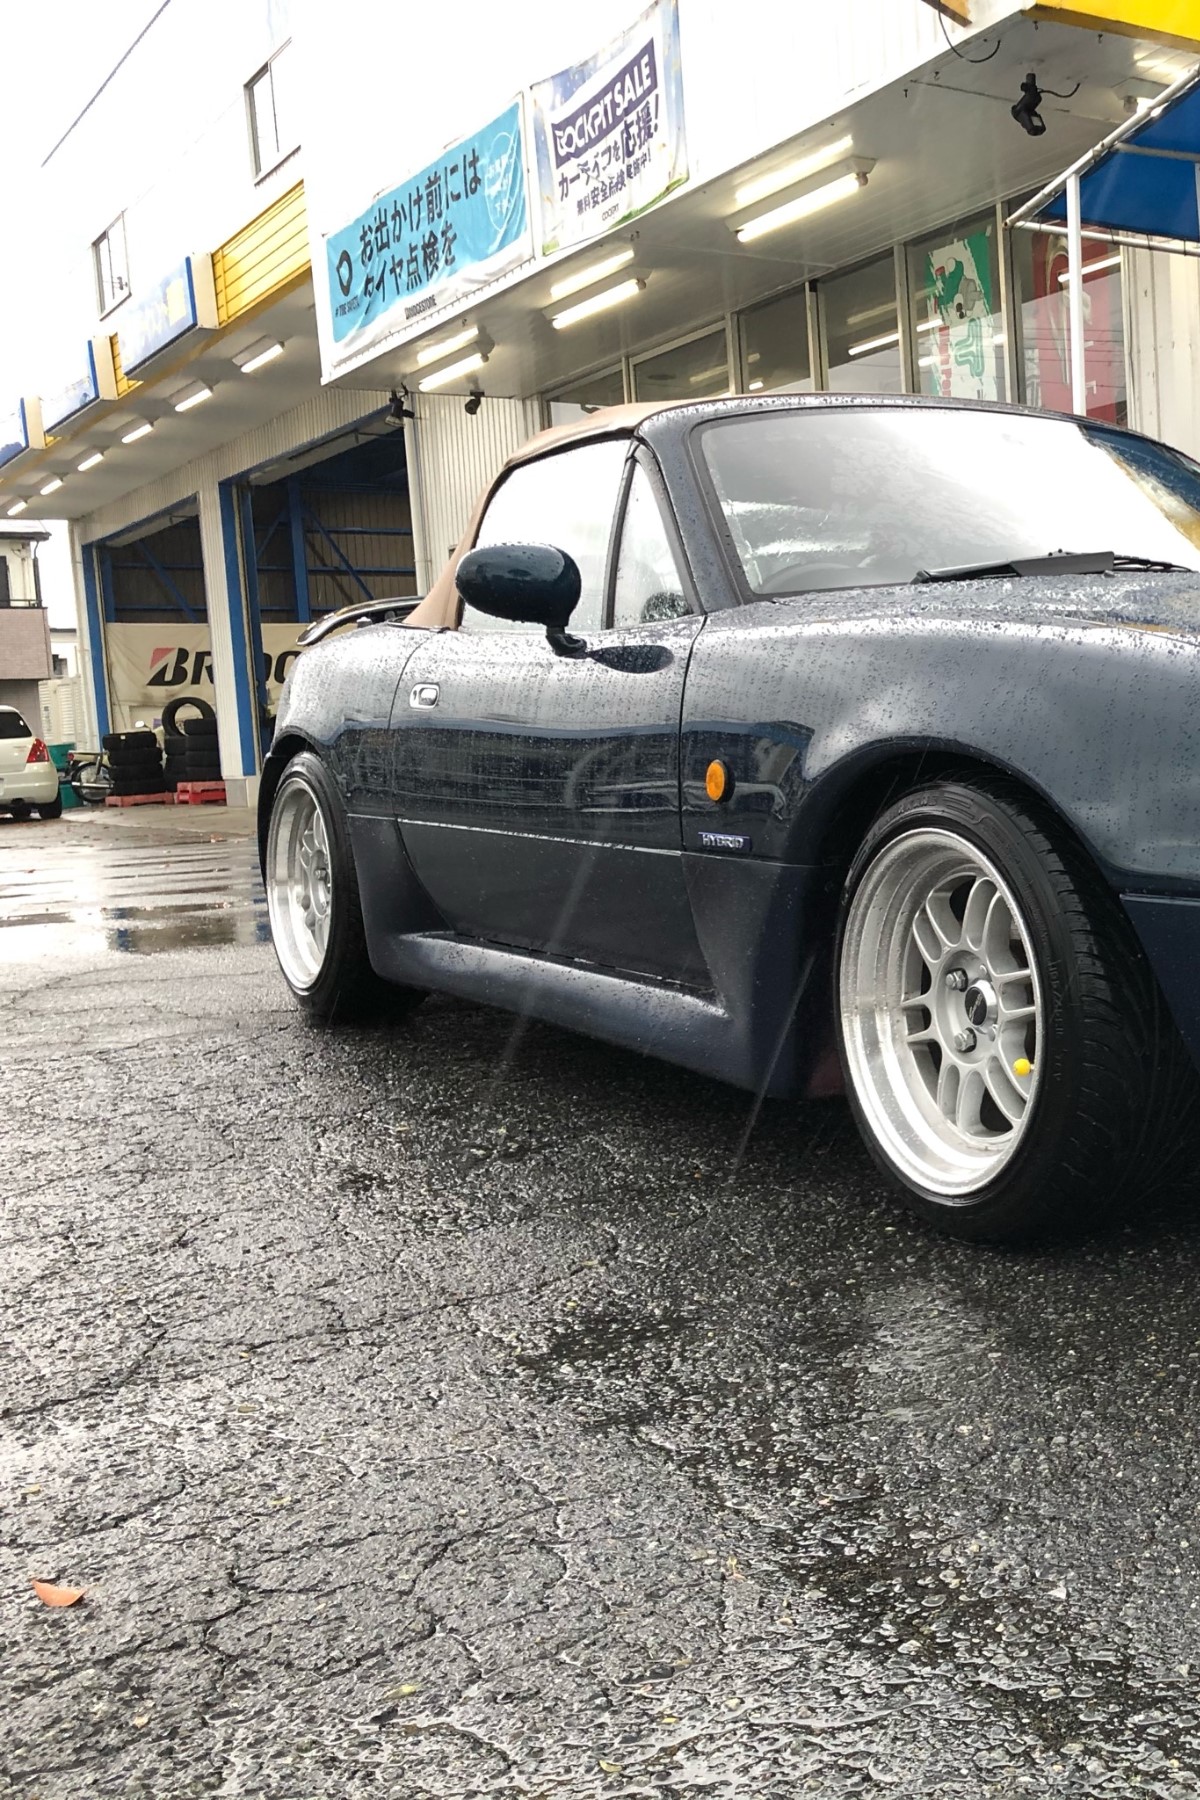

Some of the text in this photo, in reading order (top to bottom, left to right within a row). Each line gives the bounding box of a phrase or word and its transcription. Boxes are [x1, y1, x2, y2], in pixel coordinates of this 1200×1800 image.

[614, 54, 652, 116] SALE
[360, 148, 481, 268] お出かけ前には
